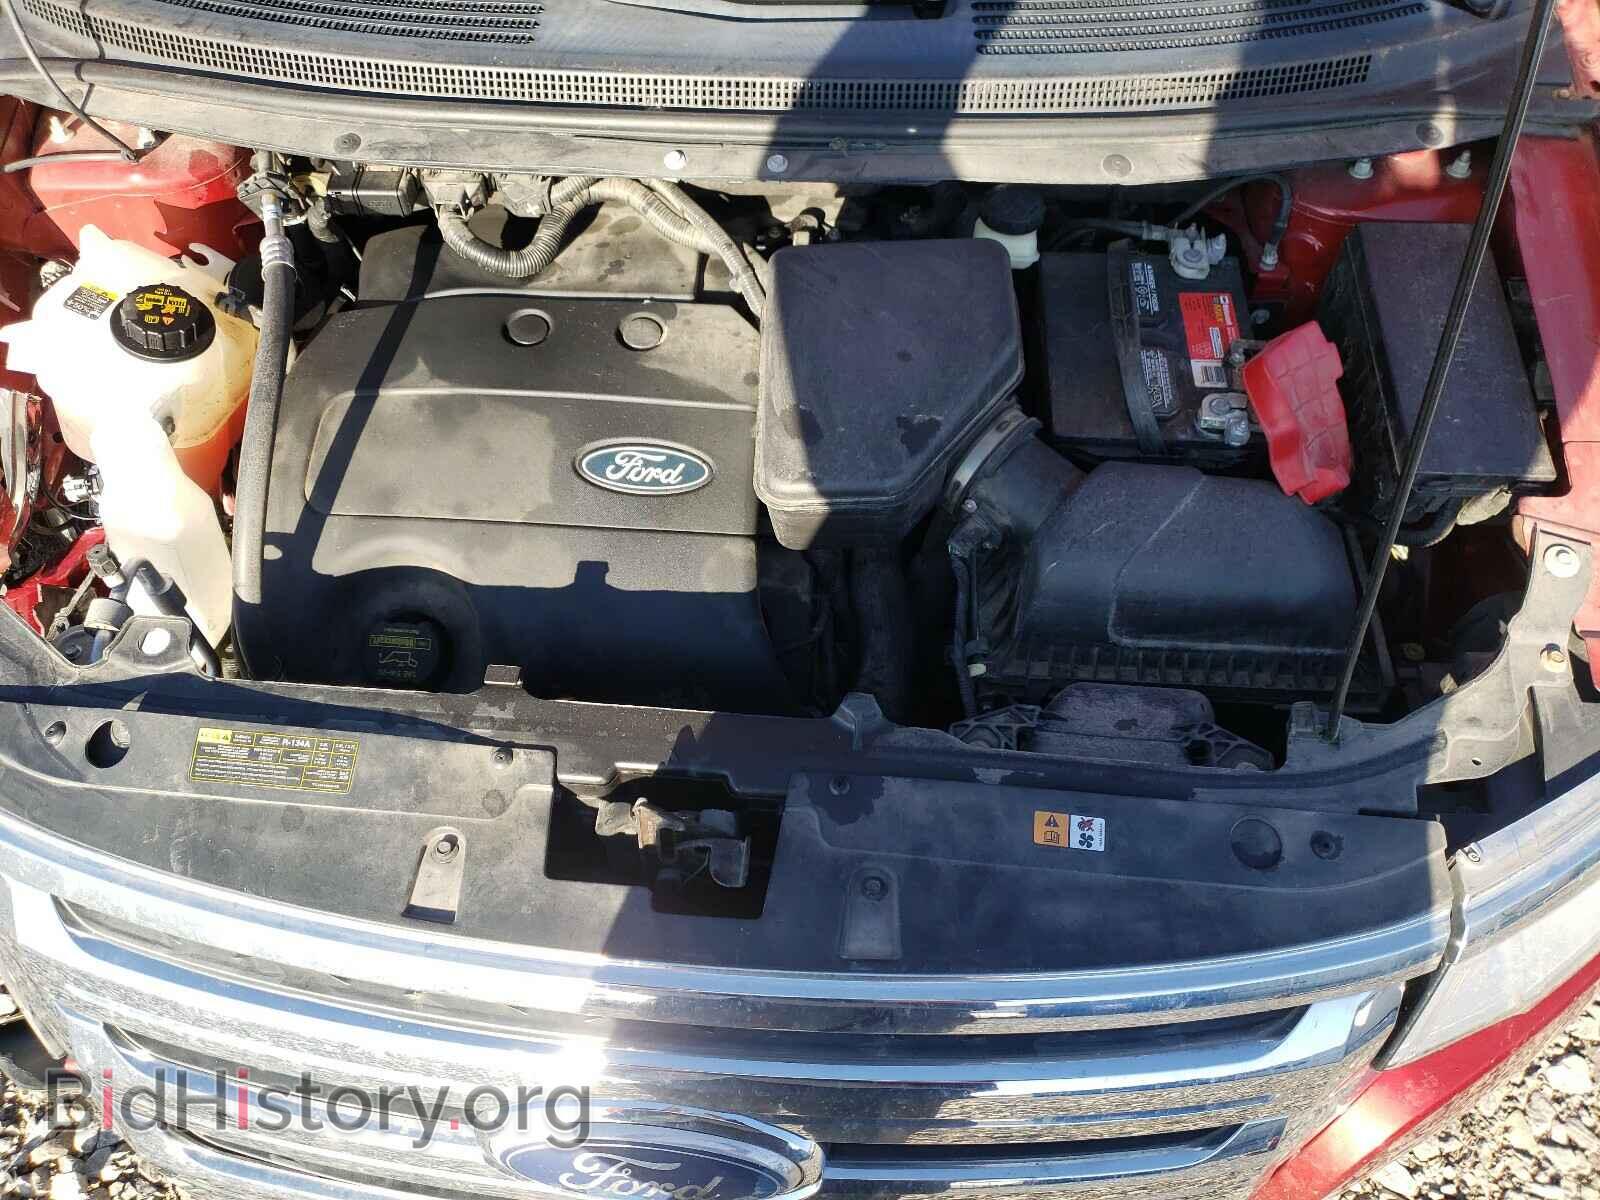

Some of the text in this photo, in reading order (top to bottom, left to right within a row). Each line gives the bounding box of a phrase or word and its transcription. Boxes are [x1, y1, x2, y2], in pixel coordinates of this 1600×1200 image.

[605, 451, 686, 485] Ford
[282, 738, 311, 748] R-134A
[559, 1152, 726, 1200] Ford
